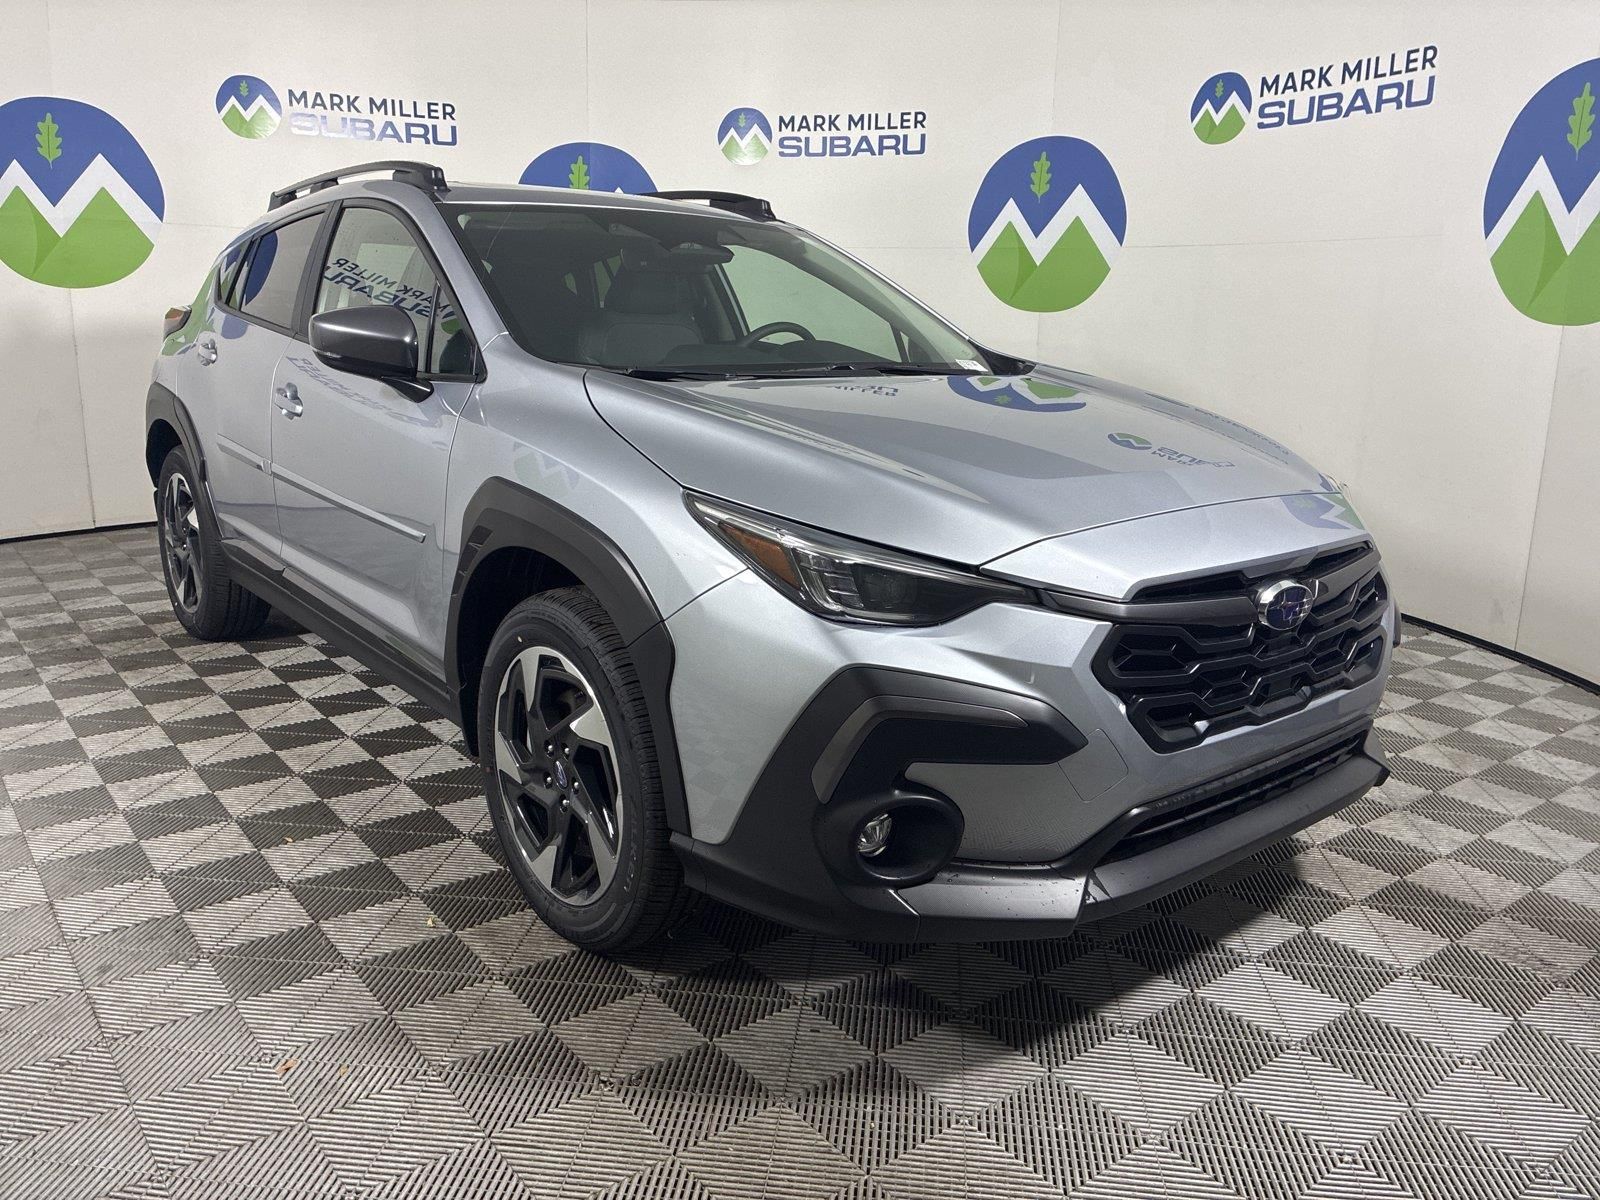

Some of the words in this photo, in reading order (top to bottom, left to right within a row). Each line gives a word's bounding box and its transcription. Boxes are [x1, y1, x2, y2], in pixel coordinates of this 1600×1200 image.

[1259, 64, 1334, 97] MARK
[1340, 45, 1438, 85] MILLER
[287, 89, 361, 113] MARK
[369, 97, 456, 121] MILLER
[1257, 75, 1436, 129] SUBARU
[289, 112, 458, 146] SUBARU
[778, 114, 841, 132] MARK
[847, 111, 927, 131] MILLER
[778, 133, 927, 158] SUBARU
